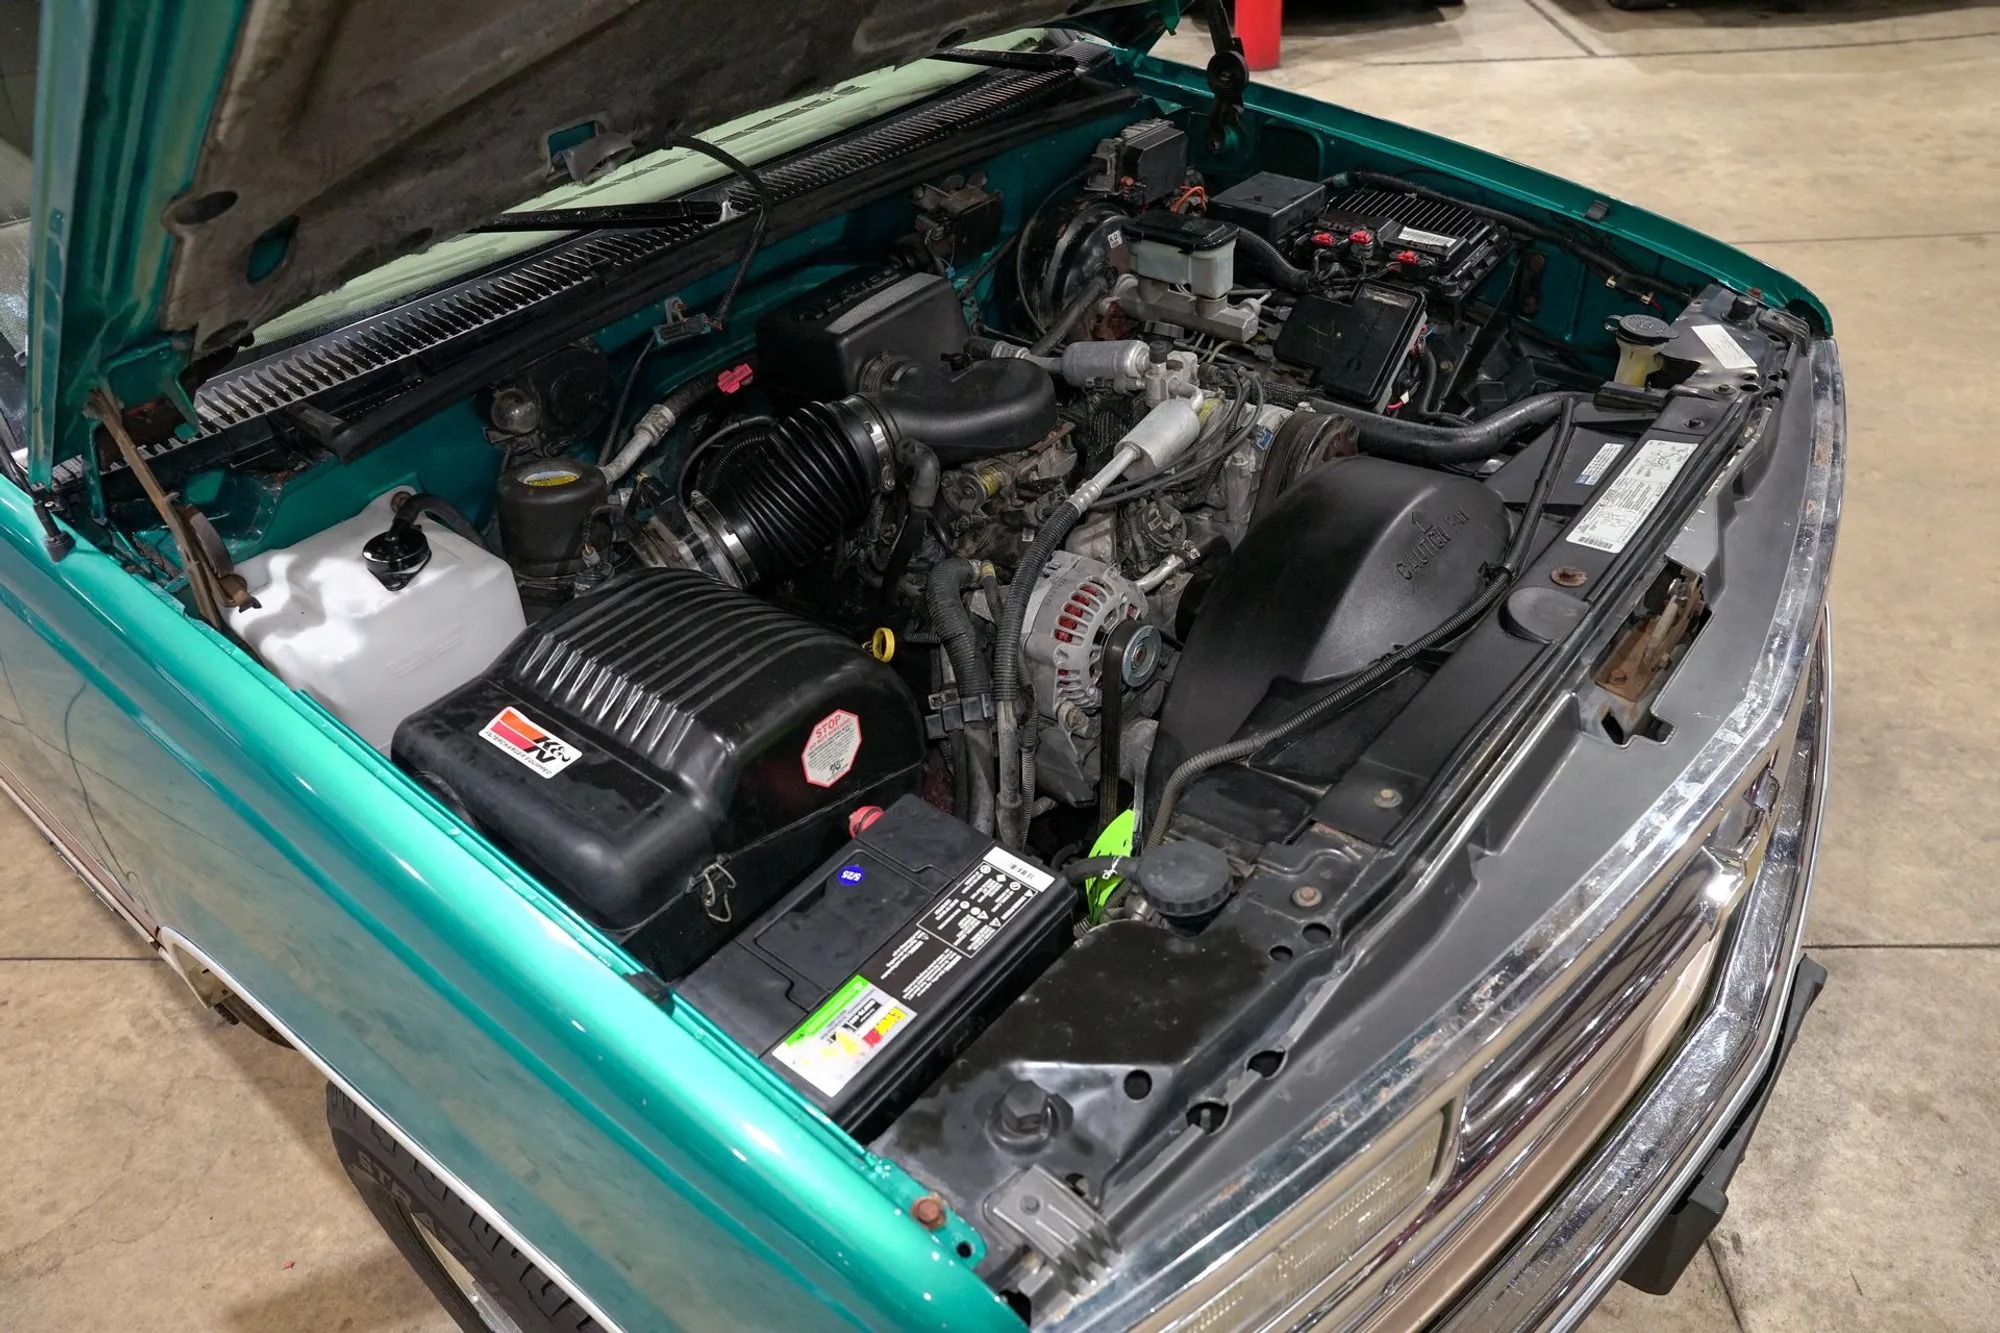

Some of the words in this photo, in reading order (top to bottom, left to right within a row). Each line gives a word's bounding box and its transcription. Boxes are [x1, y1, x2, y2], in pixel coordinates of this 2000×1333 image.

[1396, 524, 1451, 580] CAUTION
[816, 714, 841, 739] STOP
[525, 735, 571, 763] K&N
